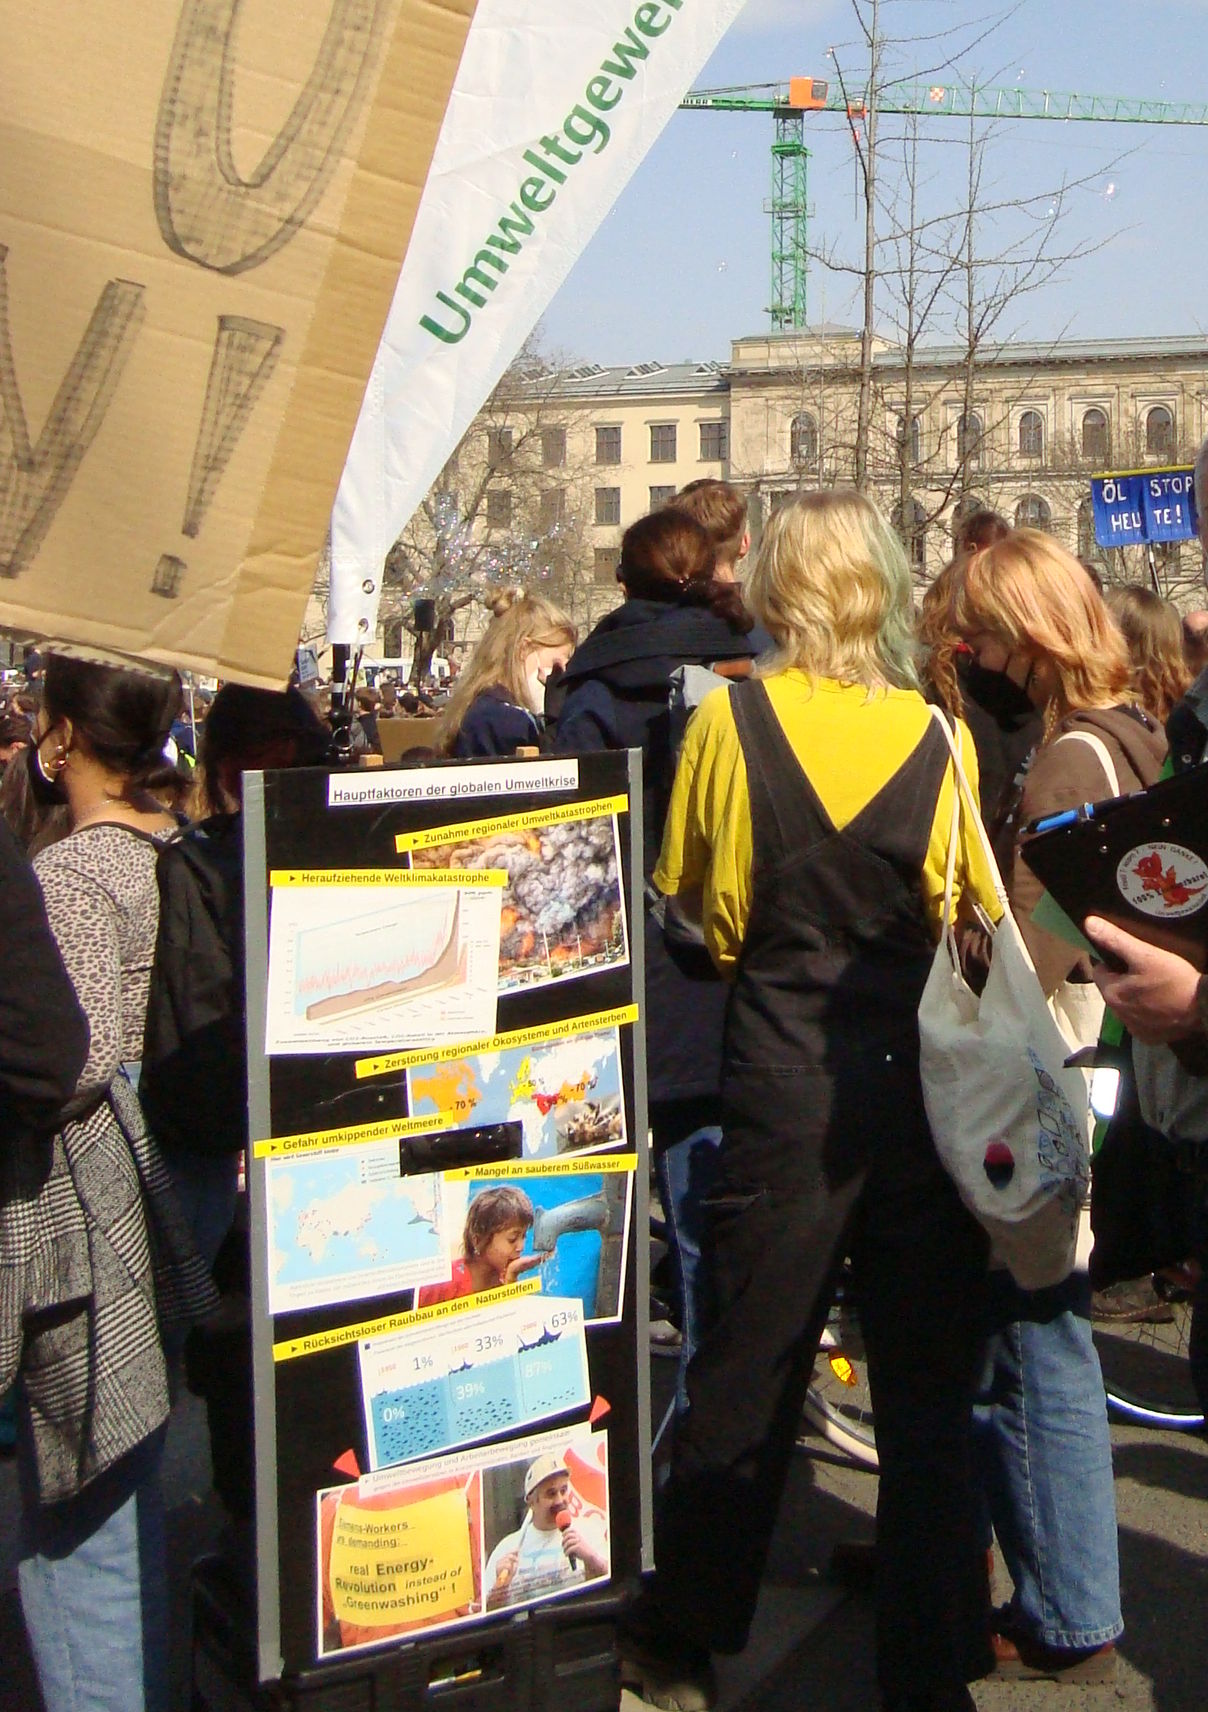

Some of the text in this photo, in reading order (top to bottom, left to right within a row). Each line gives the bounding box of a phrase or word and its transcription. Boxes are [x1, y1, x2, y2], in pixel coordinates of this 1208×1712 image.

[418, 0, 684, 344] Umweltgewe
[1102, 476, 1193, 503] ÖL STOP
[333, 776, 576, 802] Hauptfaktoren der globalen Umweltkrise
[423, 801, 613, 843] Zunahme regionaler Umweltkatastrophen
[301, 873, 490, 884] Heraufziehende Weltklimakatastrophe
[384, 1048, 439, 1069] Zerstörung
[441, 1040, 490, 1061] regionaler
[552, 1023, 570, 1035] und
[571, 1012, 627, 1031] Artensterben
[455, 1100, 466, 1110] 70
[283, 1118, 444, 1150] Gefahr umkippender Weltmeere
[475, 1160, 620, 1177] Mangel an sauberem Süßwasser
[303, 1322, 386, 1350] Rücksichtsloser
[389, 1310, 434, 1329] Raubbau
[436, 1308, 449, 1316] an
[451, 1301, 469, 1312] den
[475, 1282, 534, 1305] Naturstoffen
[551, 1310, 579, 1328] 63%
[475, 1335, 504, 1352] 33%
[413, 1355, 434, 1370] 1%
[456, 1382, 485, 1400] 39%
[383, 1406, 405, 1422] 0%
[444, 1457, 458, 1466] und
[350, 1557, 434, 1576] real Energy-
[335, 1566, 462, 1593] Revolution instead of
